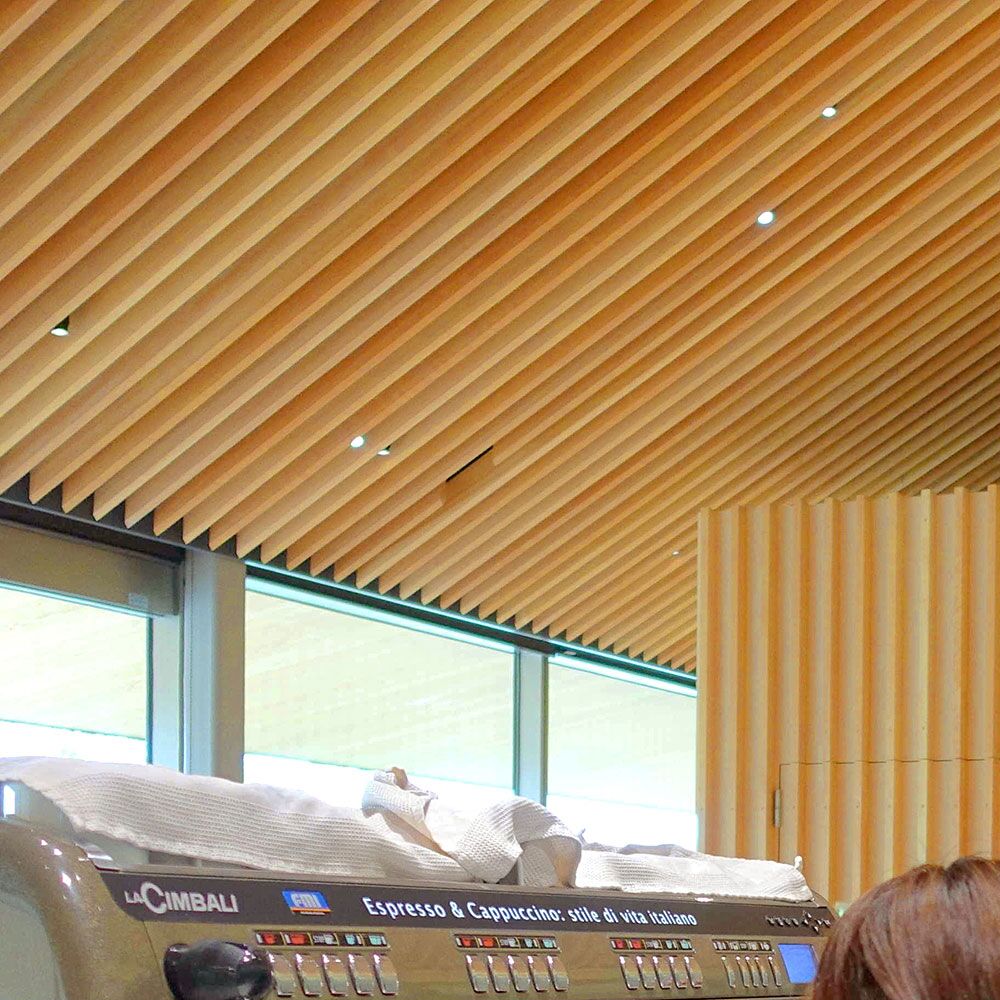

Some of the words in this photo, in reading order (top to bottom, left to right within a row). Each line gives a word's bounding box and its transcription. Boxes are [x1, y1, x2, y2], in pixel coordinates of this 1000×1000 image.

[124, 890, 143, 904] LA
[141, 881, 239, 914] CIMBALI
[362, 896, 446, 919] Espresso
[449, 901, 464, 918] &
[466, 902, 566, 923] Cappuccino:
[567, 906, 601, 923] stile
[603, 907, 619, 923] di
[620, 909, 648, 924] vita
[648, 910, 697, 926] italiano
